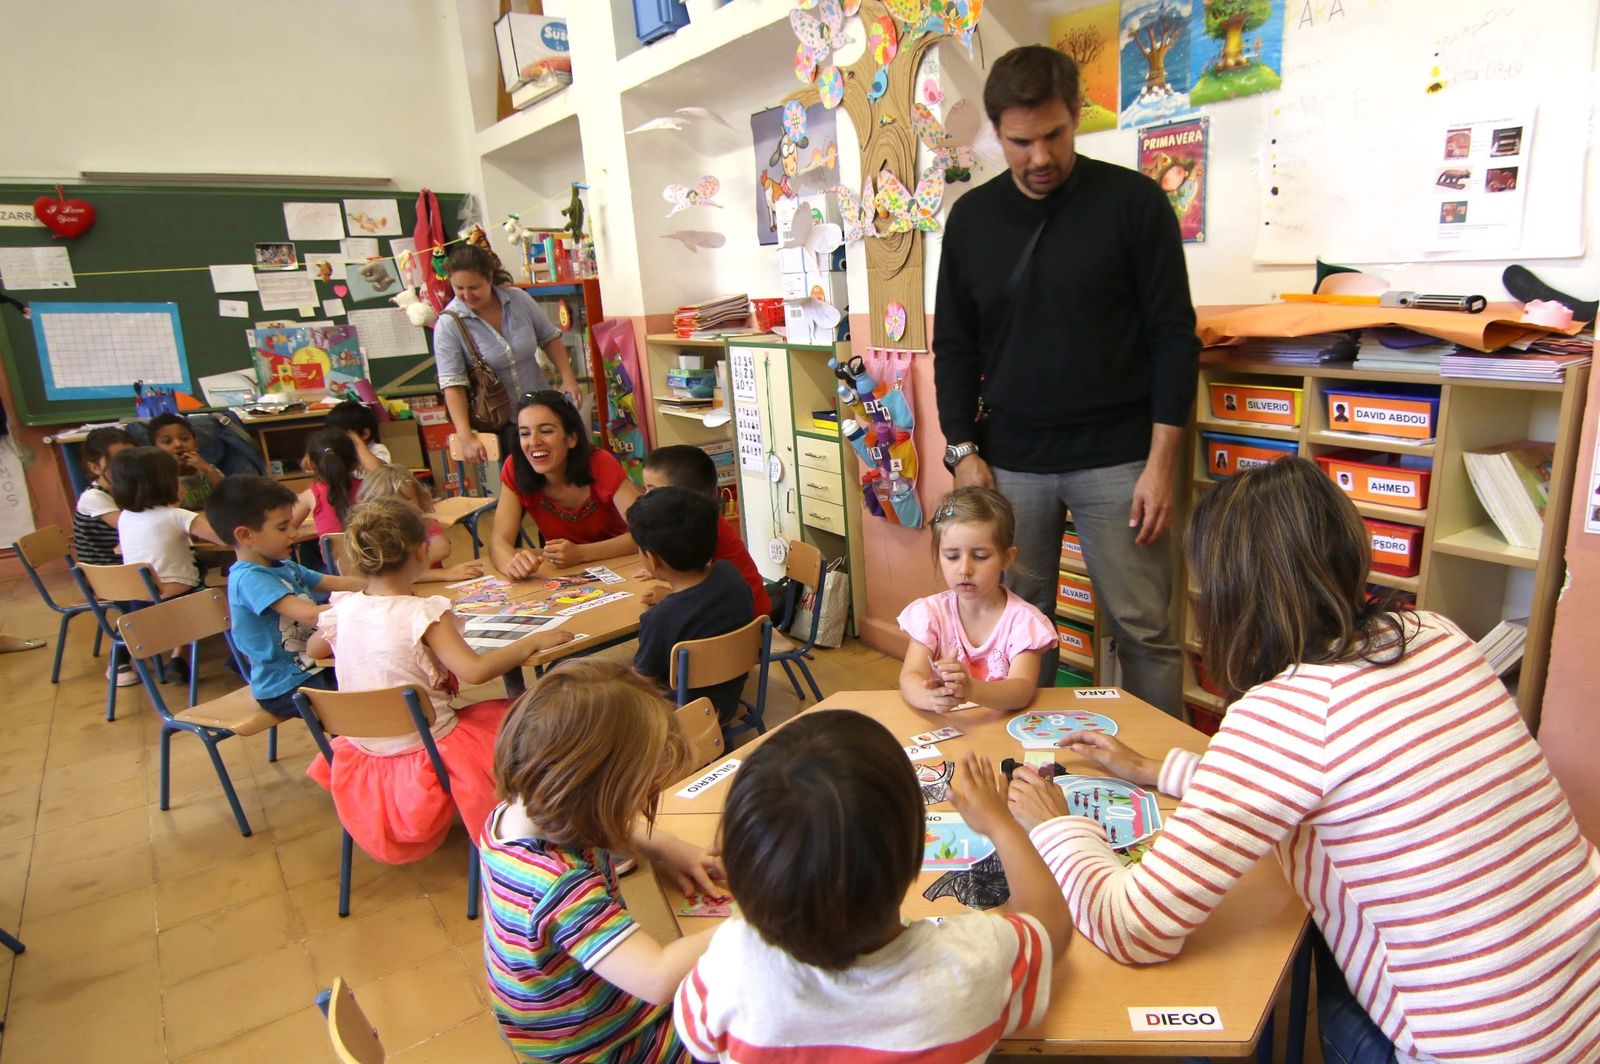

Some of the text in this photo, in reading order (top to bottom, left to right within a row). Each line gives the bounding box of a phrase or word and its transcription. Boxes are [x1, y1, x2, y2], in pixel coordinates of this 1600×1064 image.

[1143, 129, 1203, 151] PRIMAVERA
[0, 211, 36, 221] ZARR
[61, 206, 86, 214] Love
[56, 214, 79, 224] You
[1247, 401, 1289, 412] SILVERIO
[1356, 409, 1426, 425] DAVID ABDOU
[1370, 482, 1410, 494] AHMED
[1373, 539, 1406, 551] PEDRO
[1062, 634, 1081, 645] LARA
[687, 763, 737, 793] SILVERIO
[1145, 1013, 1215, 1026] DIEGO
